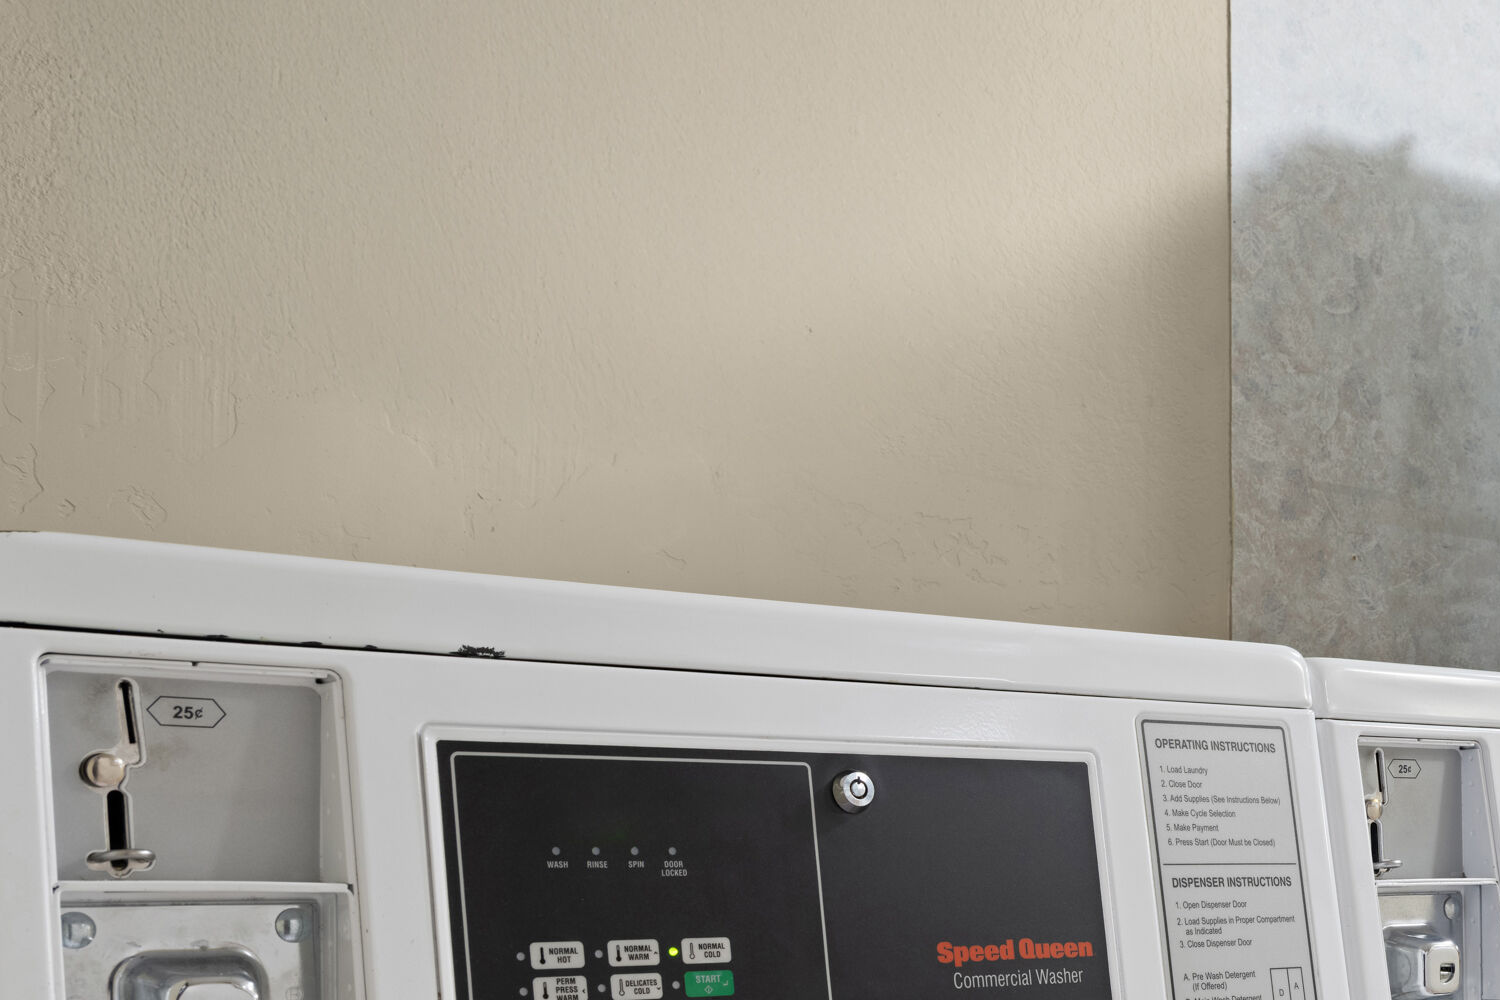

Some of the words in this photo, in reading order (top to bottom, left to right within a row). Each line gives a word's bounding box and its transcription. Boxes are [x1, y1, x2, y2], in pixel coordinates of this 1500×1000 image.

[173, 705, 204, 720] 25¢
[1155, 738, 1209, 751] OPERATING
[1210, 740, 1276, 753] INSTRUCTIONS
[1184, 766, 1208, 775] Laundry
[1169, 780, 1186, 788] Close
[1184, 795, 1210, 804] Supplies
[1211, 796, 1225, 805] (See
[1227, 796, 1259, 804] Instructions
[1261, 797, 1281, 806] Below)
[1172, 809, 1189, 817] Make
[1190, 809, 1207, 818] Cycle
[1208, 810, 1236, 818] Selection
[1192, 824, 1219, 833] Payment
[1175, 838, 1193, 846] Press
[1194, 838, 1209, 846] Start
[1210, 838, 1227, 847] (Door
[1253, 839, 1275, 848] Closed)
[547, 860, 569, 869] WASH
[586, 860, 608, 869] RINSE
[628, 860, 645, 869] SPIN
[664, 860, 684, 868] DOOR
[661, 869, 688, 877] LOCKED
[1172, 877, 1225, 888] DISPENSER
[1227, 876, 1292, 887] INSTRUCTIONS
[1183, 901, 1199, 911] Open
[1201, 901, 1231, 910] Dispenser
[1232, 900, 1247, 908] Door
[1201, 916, 1227, 926] Supplies
[1229, 916, 1234, 924] in
[1235, 916, 1254, 925] Proper
[1256, 915, 1295, 925] Compartment
[1195, 927, 1222, 935] Indicated
[1187, 940, 1205, 948] Close
[1206, 939, 1236, 948] Dispenser
[549, 948, 578, 956] NORMAL
[624, 945, 652, 953] NORMAL
[936, 939, 1015, 967] Speed
[1018, 937, 1094, 959] Queen
[557, 956, 572, 964] HOT
[696, 975, 721, 983] START
[953, 970, 1032, 989] Commercial
[1035, 968, 1083, 985] Washer
[1184, 973, 1190, 981] A.
[1192, 973, 1203, 981] Pre
[1205, 972, 1224, 980] Wash
[1225, 970, 1256, 980] Detergent
[625, 979, 658, 987] DELICATES
[1200, 982, 1227, 991] Offered)
[556, 986, 578, 994] PRESS
